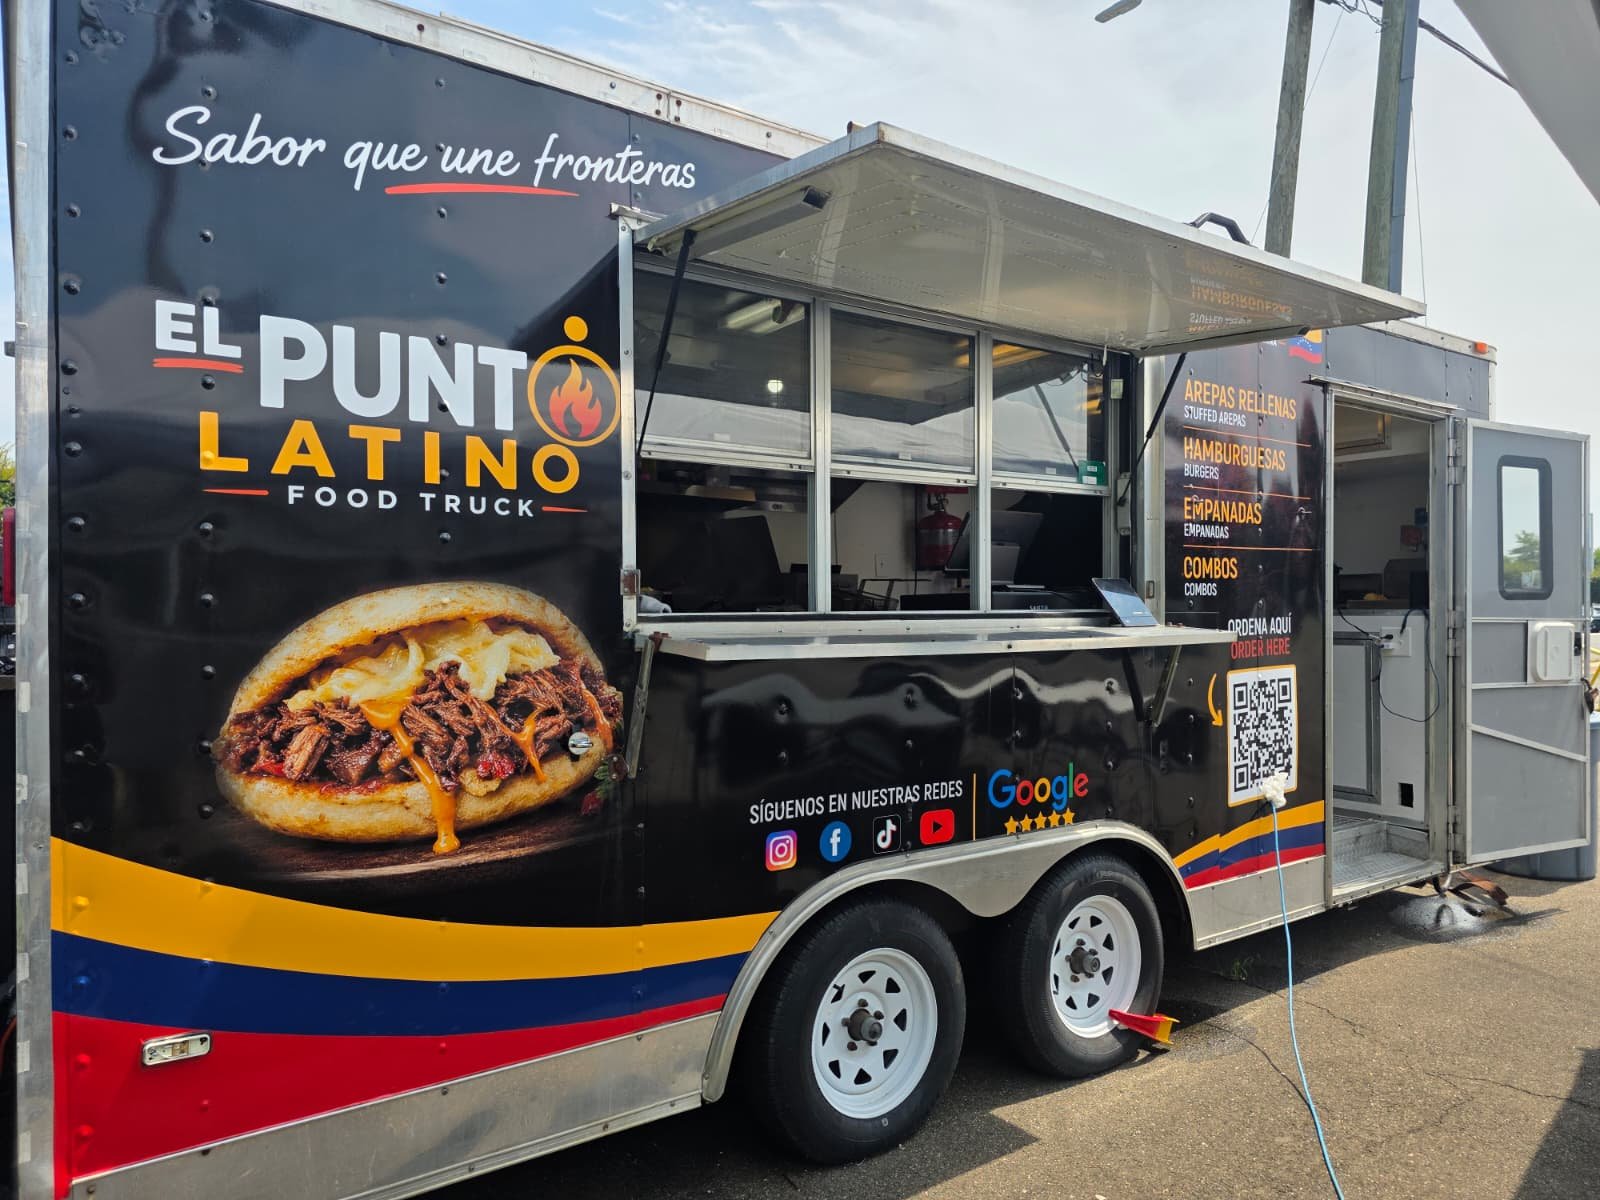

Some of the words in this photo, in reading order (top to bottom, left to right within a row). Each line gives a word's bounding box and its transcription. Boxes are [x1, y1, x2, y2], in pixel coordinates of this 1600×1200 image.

[152, 105, 327, 168] Sabor
[344, 139, 428, 191] que
[440, 144, 520, 178] une
[533, 132, 697, 191] fronteras
[154, 300, 242, 359] EL
[1184, 378, 1236, 409] AREPAS
[1239, 388, 1297, 420] RELLENAS
[1184, 405, 1218, 424] STUFFED
[1219, 410, 1247, 428] AREPAS
[199, 411, 580, 494] LATINO
[1184, 436, 1286, 472] HAMBURGUESAS
[1184, 463, 1220, 480] BURGERS
[287, 485, 398, 510] FOOD
[419, 492, 535, 518] TRUCK
[1184, 496, 1263, 525] EMPANADAS
[1184, 523, 1229, 539] EMPANADAS
[1183, 556, 1238, 579] COMBOS
[1184, 582, 1218, 596] COMBOS
[1228, 617, 1268, 637] ORDENA
[1269, 612, 1292, 634] AQUÍ
[1231, 638, 1264, 660] ORDER
[1266, 637, 1291, 656] HERE
[750, 795, 824, 824] SÍGUENOS
[828, 792, 848, 813] EN
[851, 784, 920, 811] NUESTRAS
[924, 780, 963, 802] REDES
[988, 762, 1089, 812] Google
